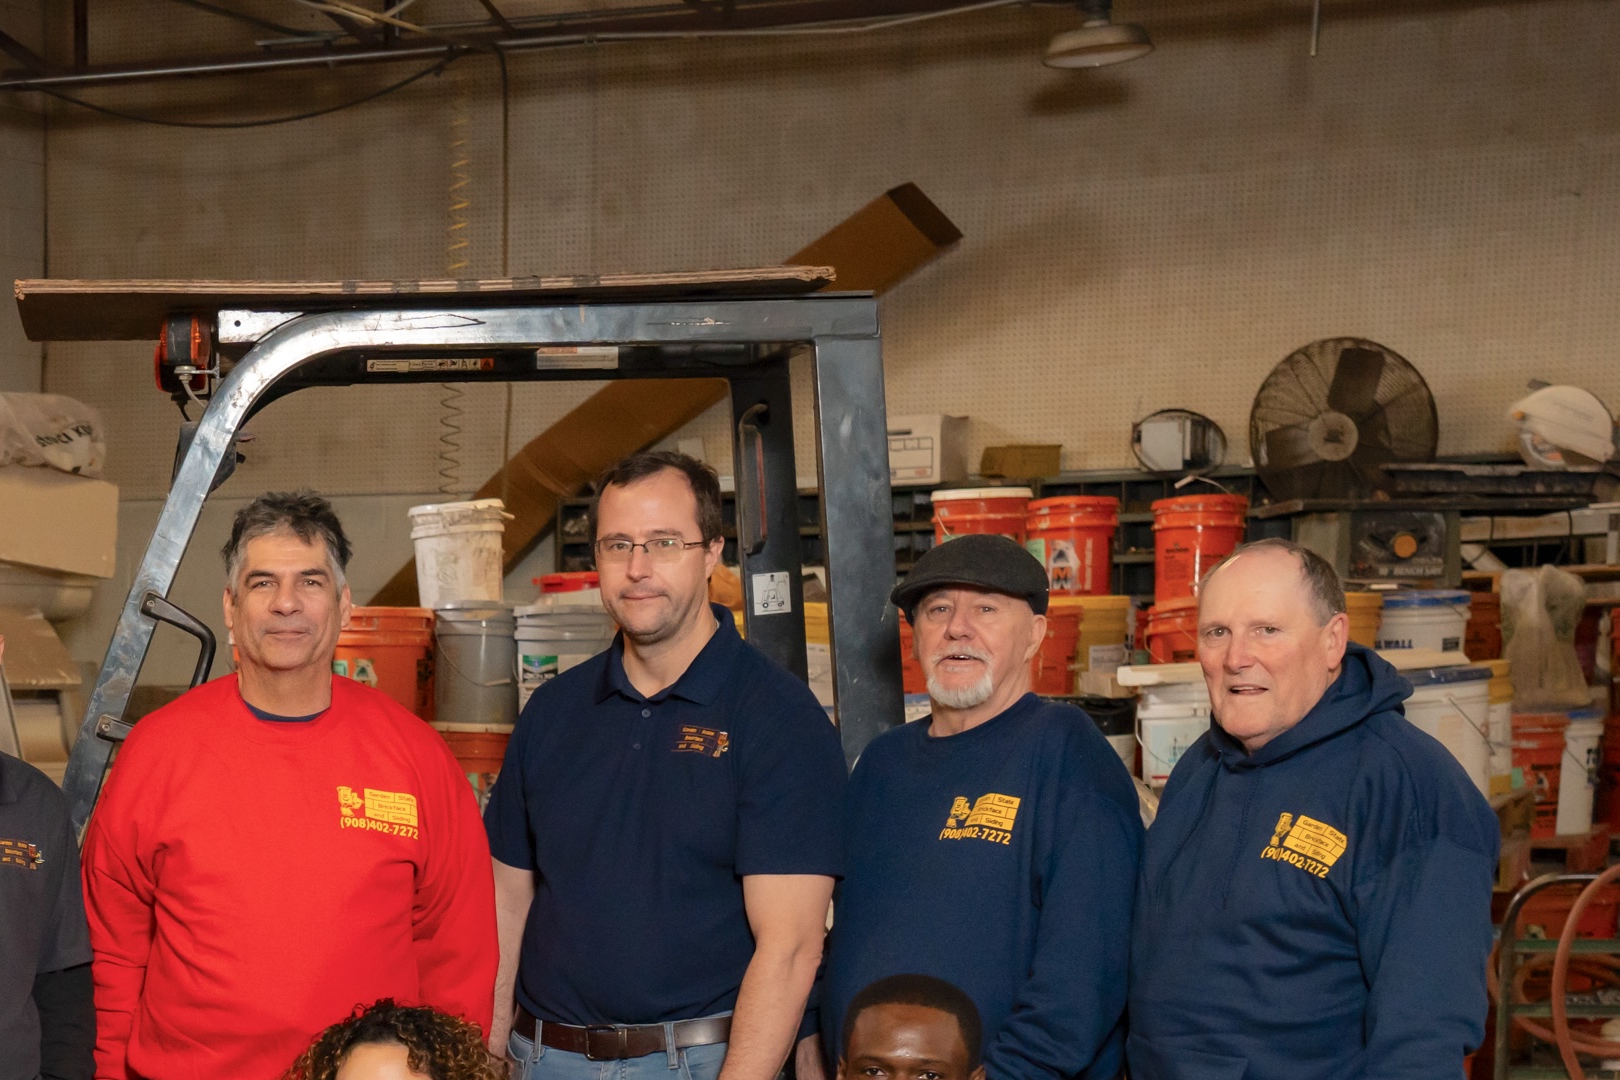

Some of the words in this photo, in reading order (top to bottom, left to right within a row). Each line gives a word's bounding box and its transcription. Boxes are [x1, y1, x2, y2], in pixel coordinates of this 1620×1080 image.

[369, 791, 391, 800] Garden
[997, 797, 1015, 805] State
[377, 803, 406, 812] Brickface
[392, 815, 411, 824] Siding
[985, 818, 1004, 827] Siding
[340, 816, 419, 840] (908)402-7272
[1302, 820, 1323, 831] Garden
[1294, 843, 1306, 851] and
